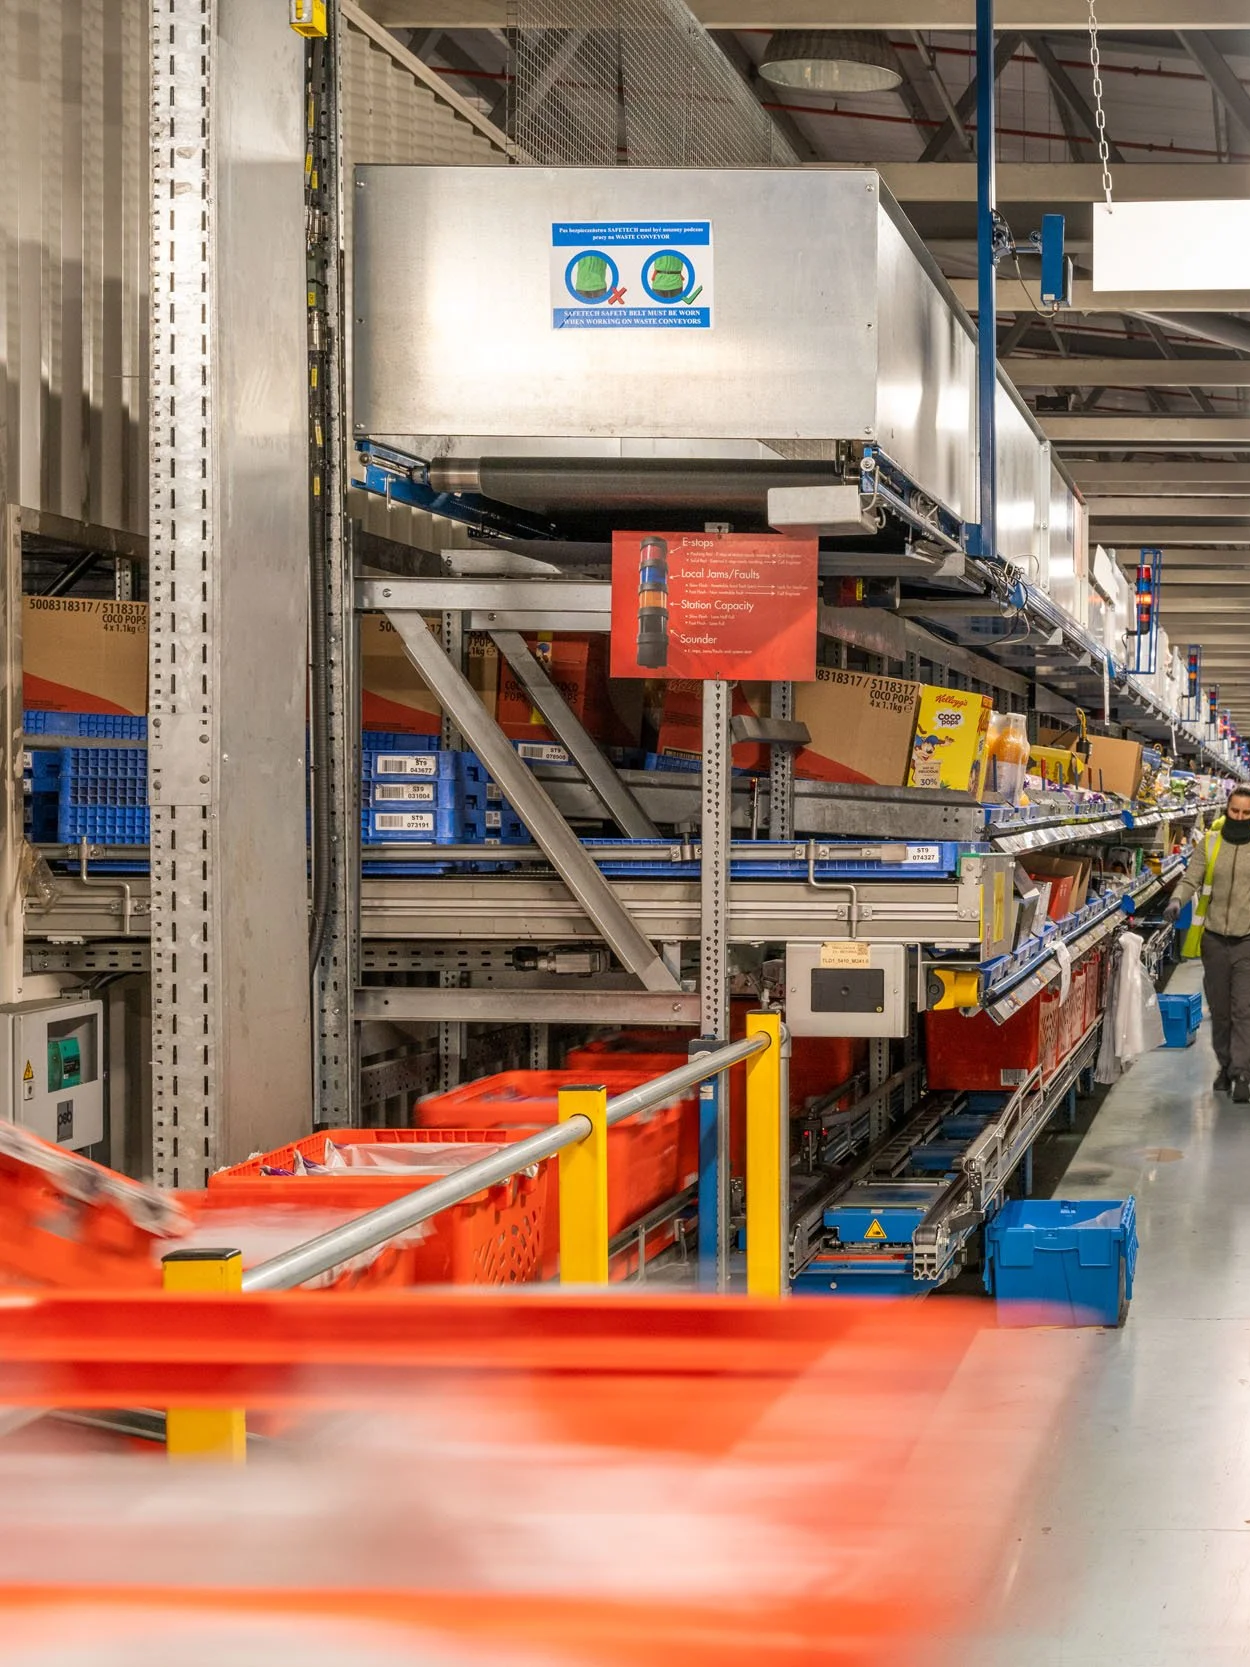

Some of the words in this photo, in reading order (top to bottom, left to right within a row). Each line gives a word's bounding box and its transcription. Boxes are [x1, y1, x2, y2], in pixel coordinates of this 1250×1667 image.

[682, 537, 714, 549] E-stops
[681, 568, 704, 578] Local
[706, 568, 760, 580] Jams/Faults
[29, 598, 93, 612] 5008318317
[95, 602, 100, 614] /
[102, 603, 147, 616] 5118317
[681, 600, 712, 610] Station
[714, 600, 754, 613] Capacity
[102, 614, 123, 624] COCO
[125, 615, 147, 625] POPS
[103, 624, 108, 632] 4
[116, 624, 136, 634] 1.1kg
[680, 633, 717, 644] Sounder
[863, 677, 870, 688] /
[870, 678, 916, 695] 5118317
[870, 690, 890, 700] COCO
[892, 693, 914, 705] POPS
[935, 694, 968, 708] Kellogg's
[870, 698, 875, 708] 4
[882, 701, 902, 714] 1.1kg
[941, 719, 959, 727] pops
[920, 778, 938, 786] 30%
[58, 1102, 73, 1136] psb
